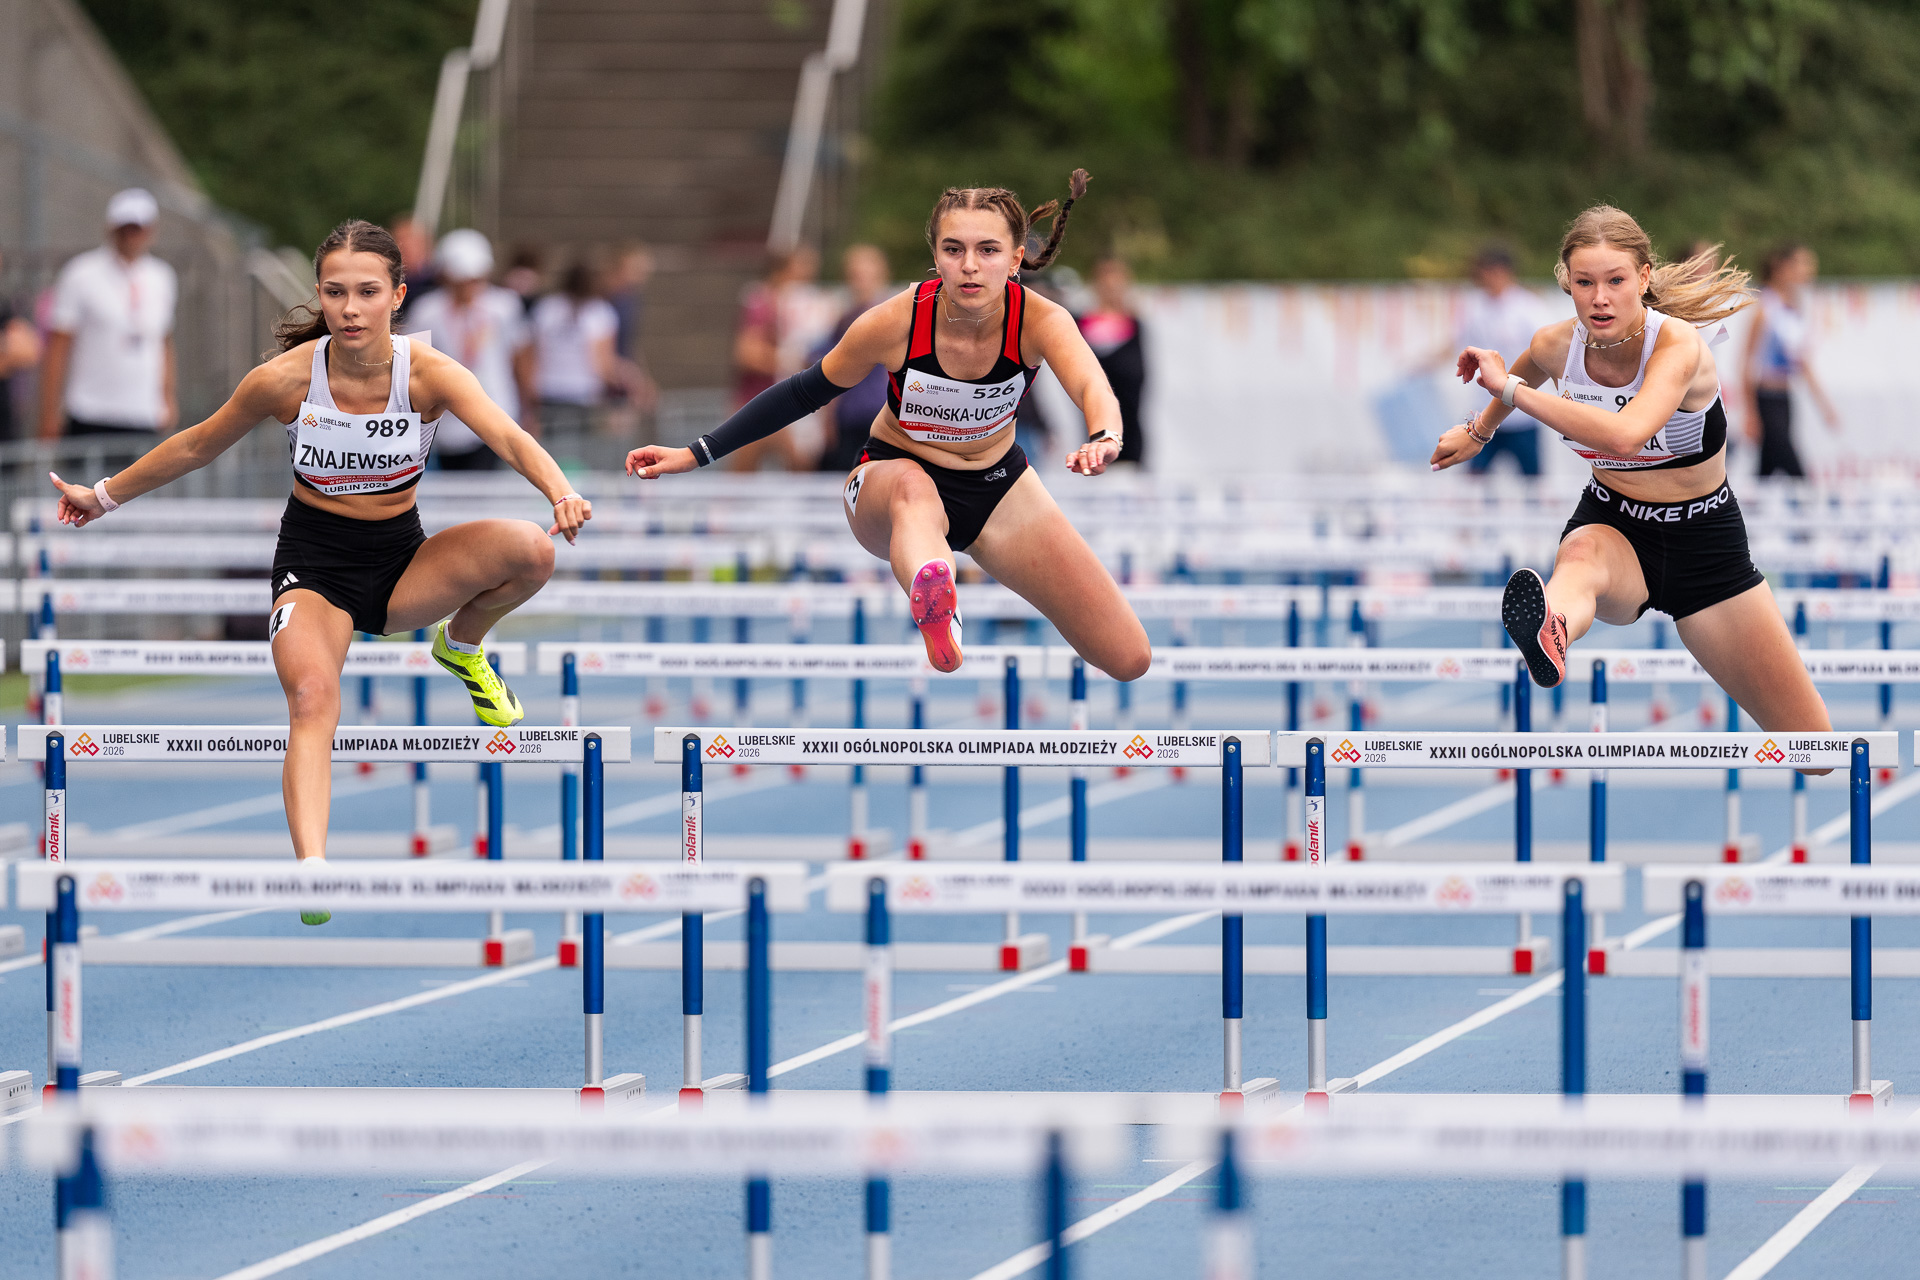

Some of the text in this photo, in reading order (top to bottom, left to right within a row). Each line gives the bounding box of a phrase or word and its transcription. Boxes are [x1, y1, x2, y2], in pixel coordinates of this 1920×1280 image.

[926, 384, 960, 394] LUBELSKIE
[972, 382, 1016, 400] 526
[1573, 392, 1603, 402] LUBELSKIE
[905, 396, 1017, 422] BROŃSKA-UCZEŃ
[319, 416, 352, 429] LUBELSKIE
[365, 418, 409, 438] 989
[926, 431, 989, 442] LUBLIN 2026
[298, 443, 414, 470] ZNAJEWSKA
[1593, 460, 1626, 468] LUBLIN
[324, 482, 389, 493] LUBLIN 2026
[848, 474, 861, 504] 3
[1619, 499, 1684, 523] NIKE
[1687, 486, 1729, 519] PRO
[270, 607, 284, 638] 4
[102, 733, 160, 745] LUBELSKIE
[519, 730, 579, 742] LUBELSKIE
[738, 735, 796, 746] LUBELSKIE
[1157, 736, 1217, 747] LUBELSKIE
[166, 736, 480, 752] XXXII OGÓLNOPOL LIMPIADA MŁODZIEŻY
[519, 743, 542, 755] 2026
[802, 738, 1118, 755] XXXII OGÓLNOPOLSKA OLIMPIADA MŁODZIEŻY
[1364, 740, 1423, 752] LUBELSKIE
[1788, 740, 1849, 752] LUBELSKIE
[102, 746, 125, 756] 2026
[738, 748, 760, 758] 2026
[1157, 749, 1180, 759] 2026
[1429, 743, 1749, 760] XXXII OGÓLNOPOLSKA OLIMPIADA MŁODZIEŻY
[1364, 753, 1387, 764] 2026
[1788, 753, 1811, 764] 2026
[48, 812, 61, 864] polanik
